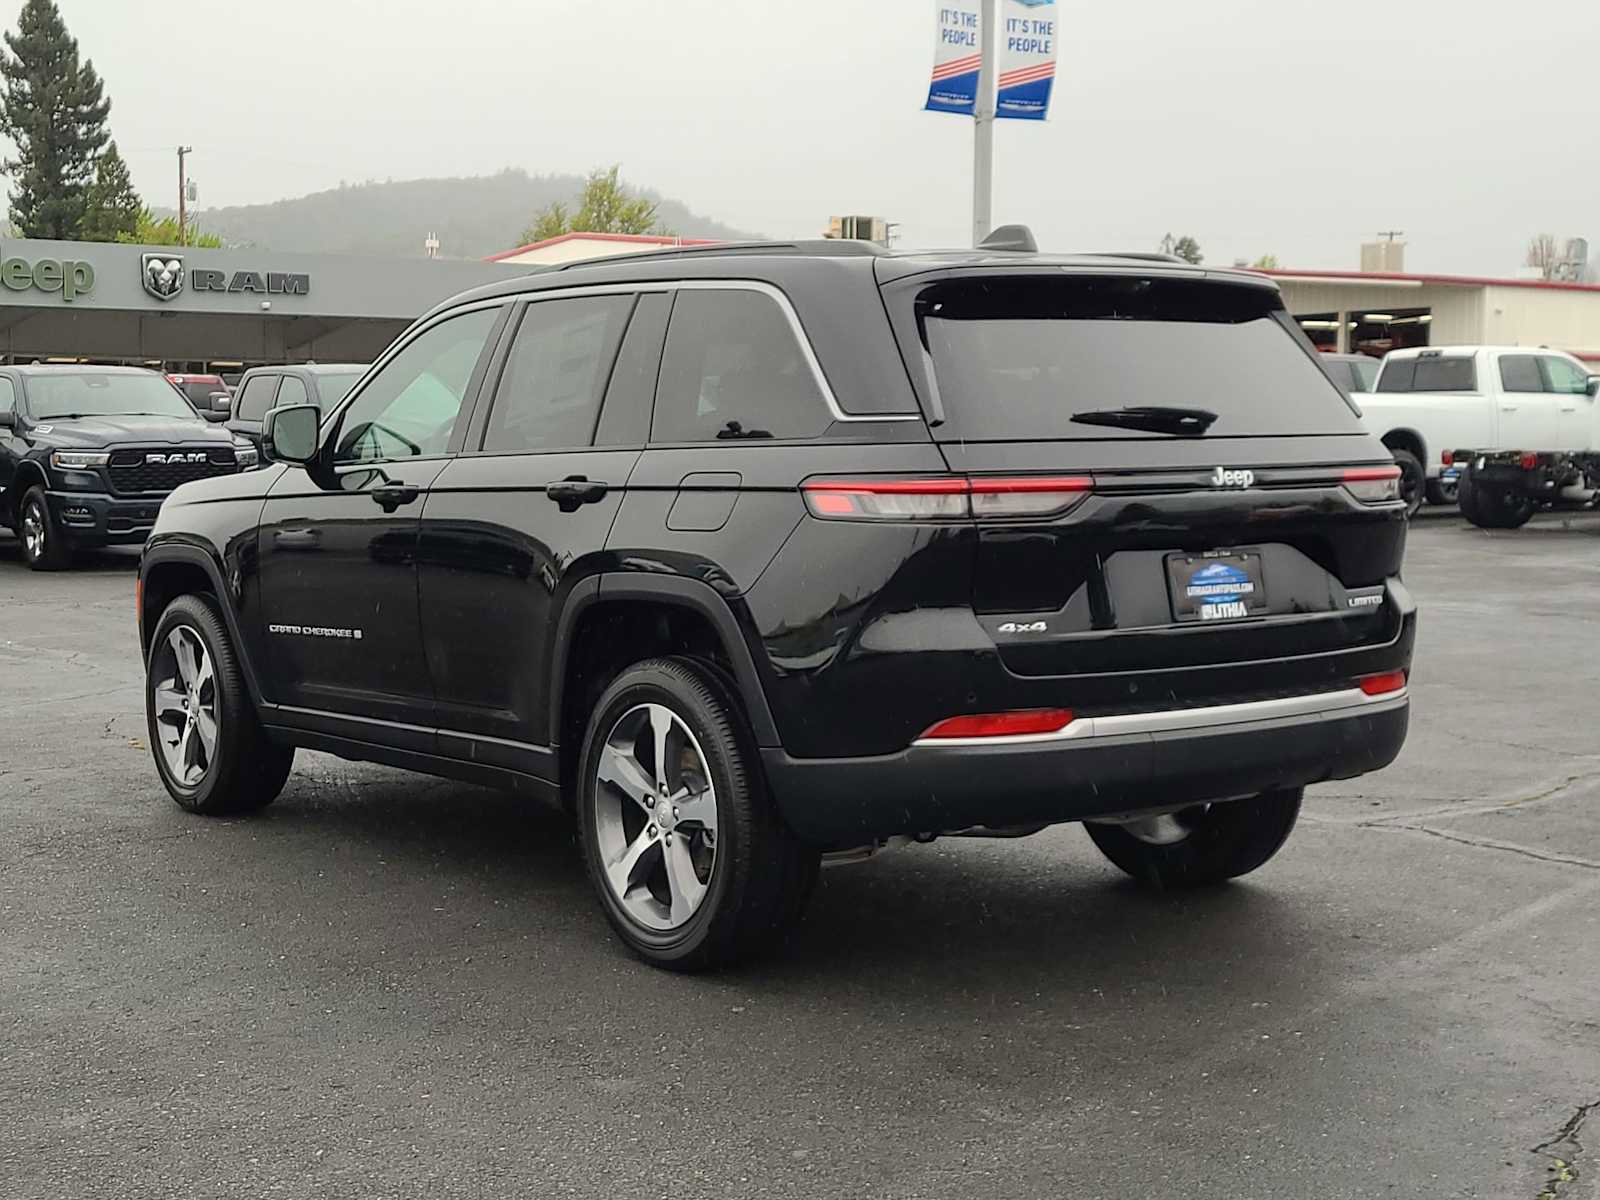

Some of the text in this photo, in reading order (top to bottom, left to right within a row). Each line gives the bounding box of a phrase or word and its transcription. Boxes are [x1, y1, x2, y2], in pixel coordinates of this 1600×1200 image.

[940, 9, 977, 28] IT'S THE
[1006, 18, 1053, 36] IT'S THE
[942, 29, 976, 47] PEOPLE
[1008, 37, 1051, 54] PEOPLE
[0, 256, 96, 301] eep
[192, 268, 310, 295] RAM
[145, 453, 207, 464] RAM
[1211, 466, 1254, 488] Jeep
[302, 626, 352, 637] CHEROKEE
